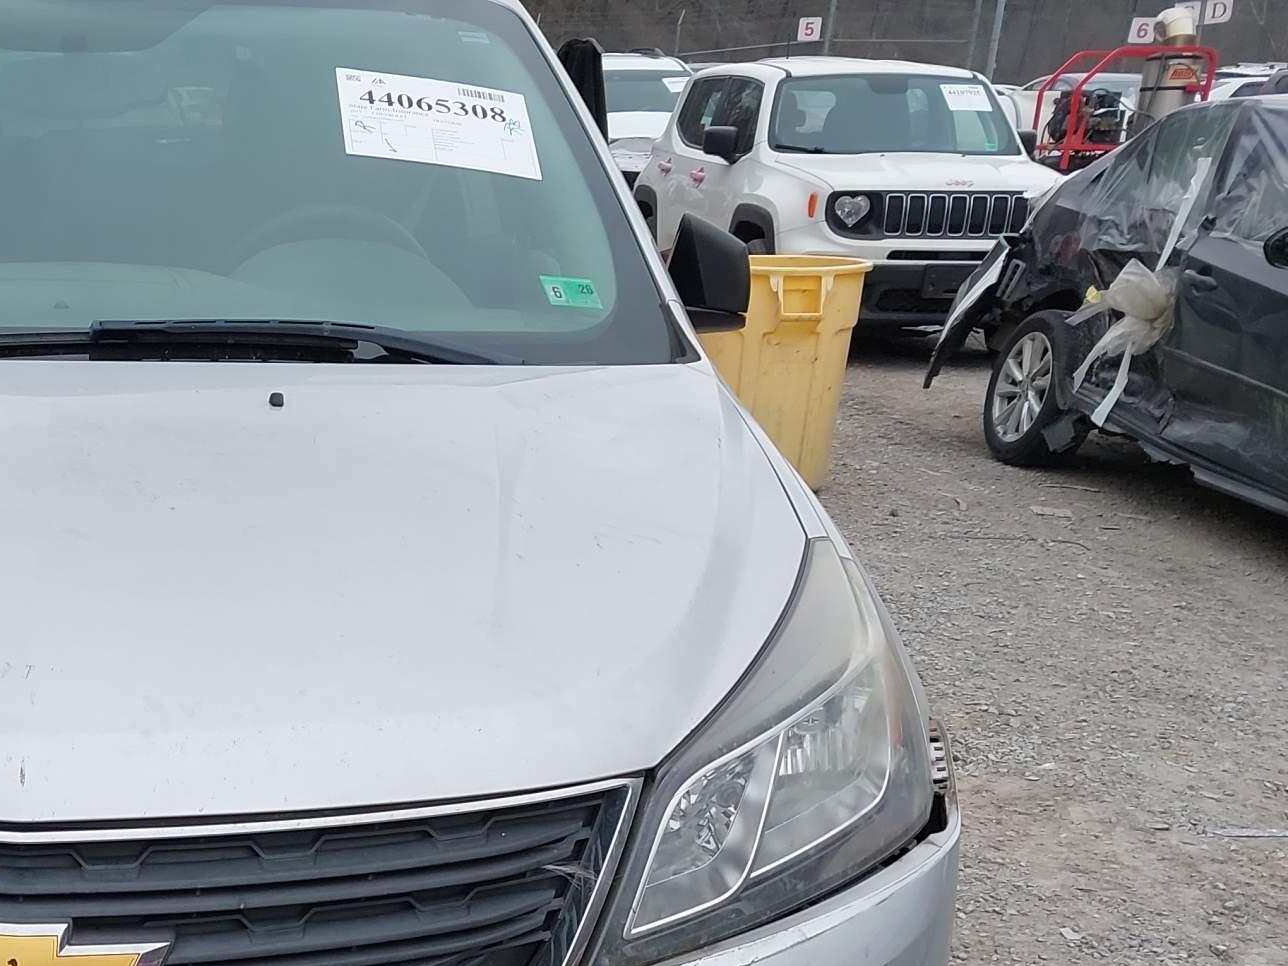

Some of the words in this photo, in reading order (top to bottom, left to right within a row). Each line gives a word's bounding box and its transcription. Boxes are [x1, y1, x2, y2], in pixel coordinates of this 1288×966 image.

[1211, 2, 1227, 19] D
[804, 22, 815, 37] 5
[1137, 23, 1150, 39] 6
[359, 90, 506, 123] 44065308
[552, 286, 563, 299] 6
